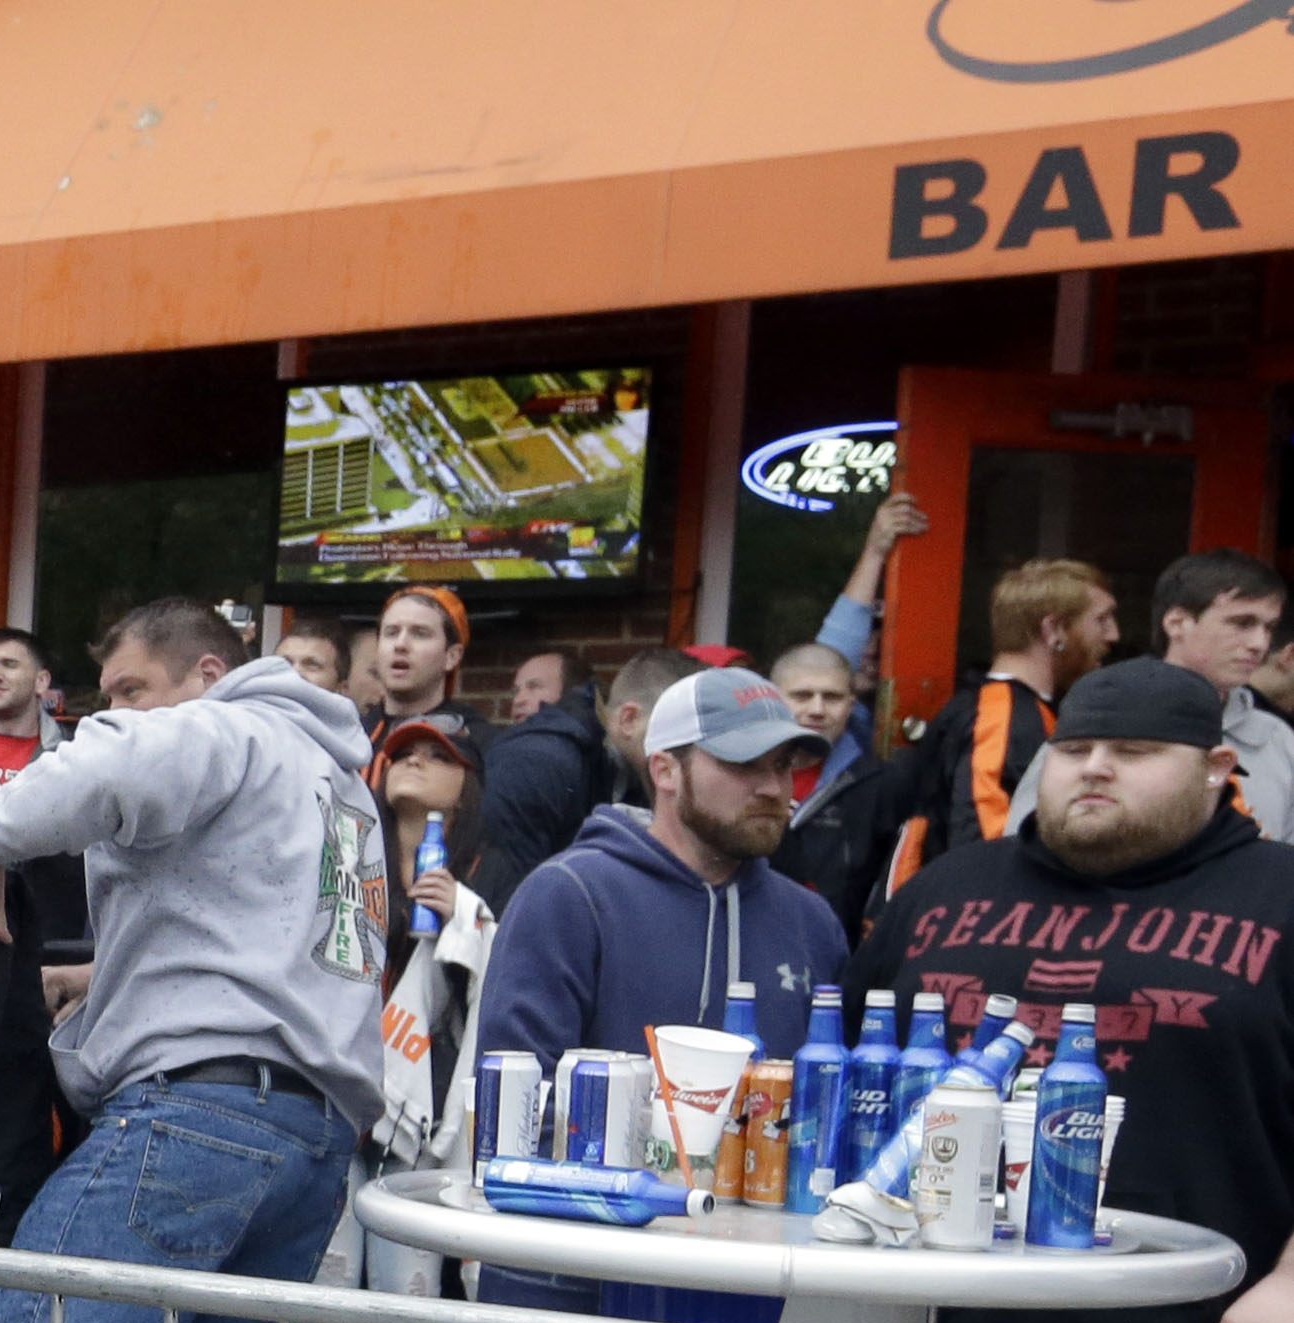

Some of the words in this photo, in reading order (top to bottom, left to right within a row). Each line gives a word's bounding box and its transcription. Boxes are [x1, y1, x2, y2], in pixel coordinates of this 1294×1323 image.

[888, 131, 1242, 260] BAR
[336, 901, 353, 965] FIRE
[852, 1089, 887, 1101] UD
[1066, 1111, 1106, 1125] BU
